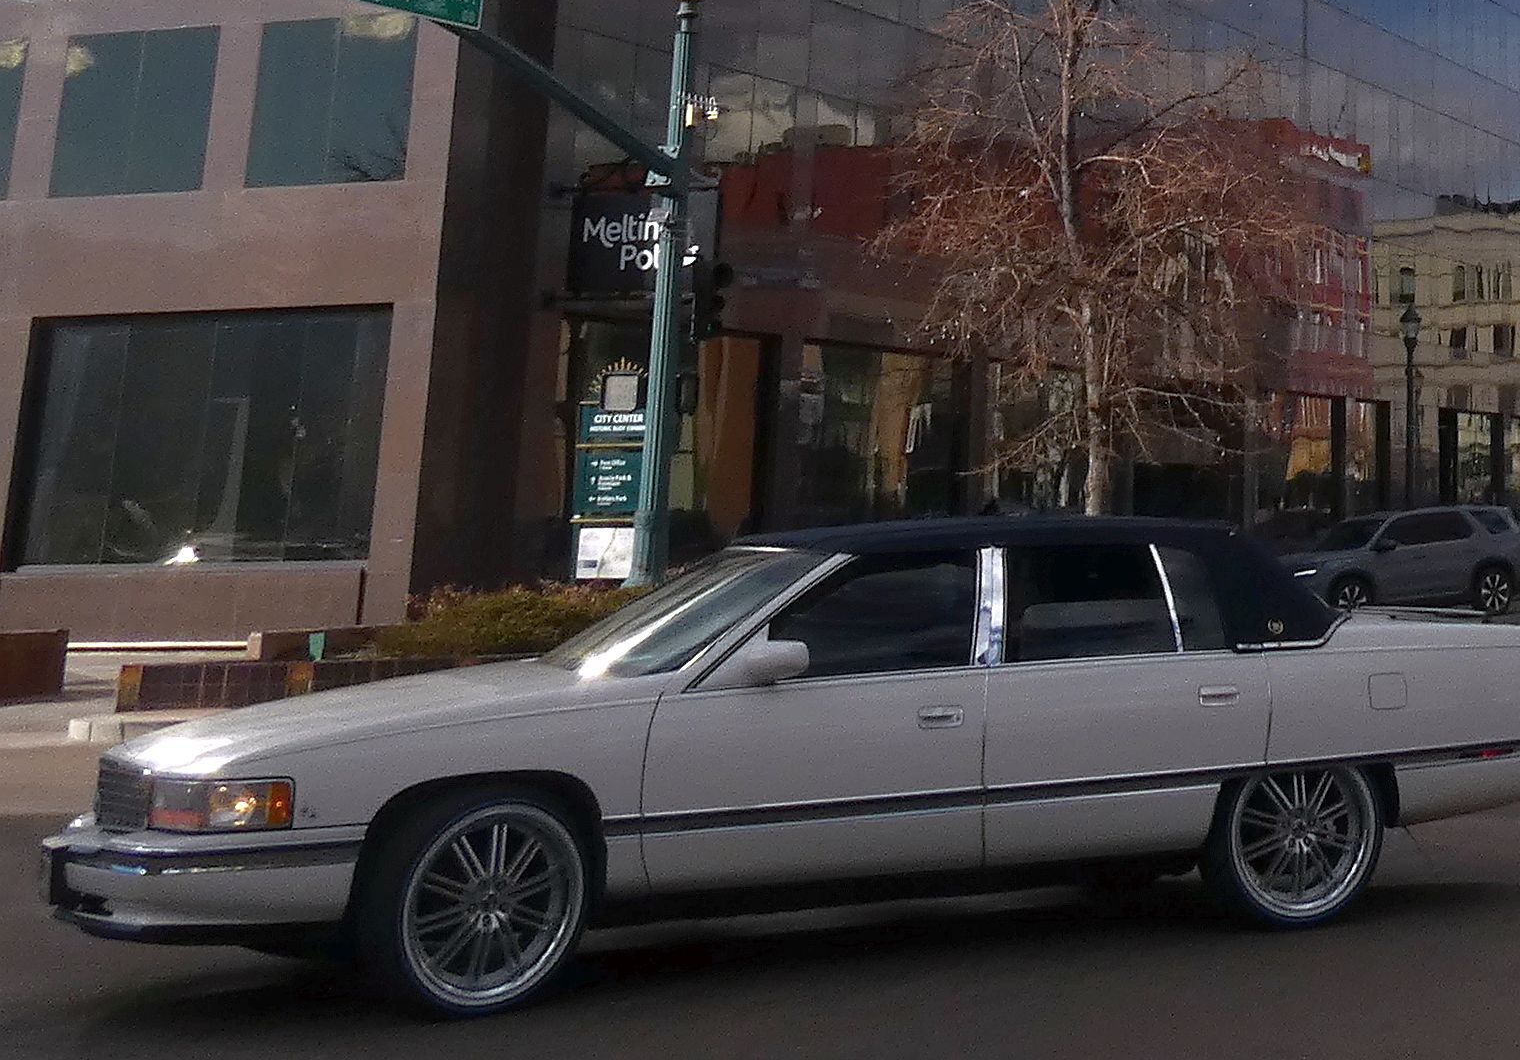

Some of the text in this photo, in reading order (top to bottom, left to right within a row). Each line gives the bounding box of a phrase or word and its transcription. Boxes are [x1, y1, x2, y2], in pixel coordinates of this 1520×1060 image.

[583, 213, 660, 248] Meltin
[593, 413, 644, 424] CITY CENTER
